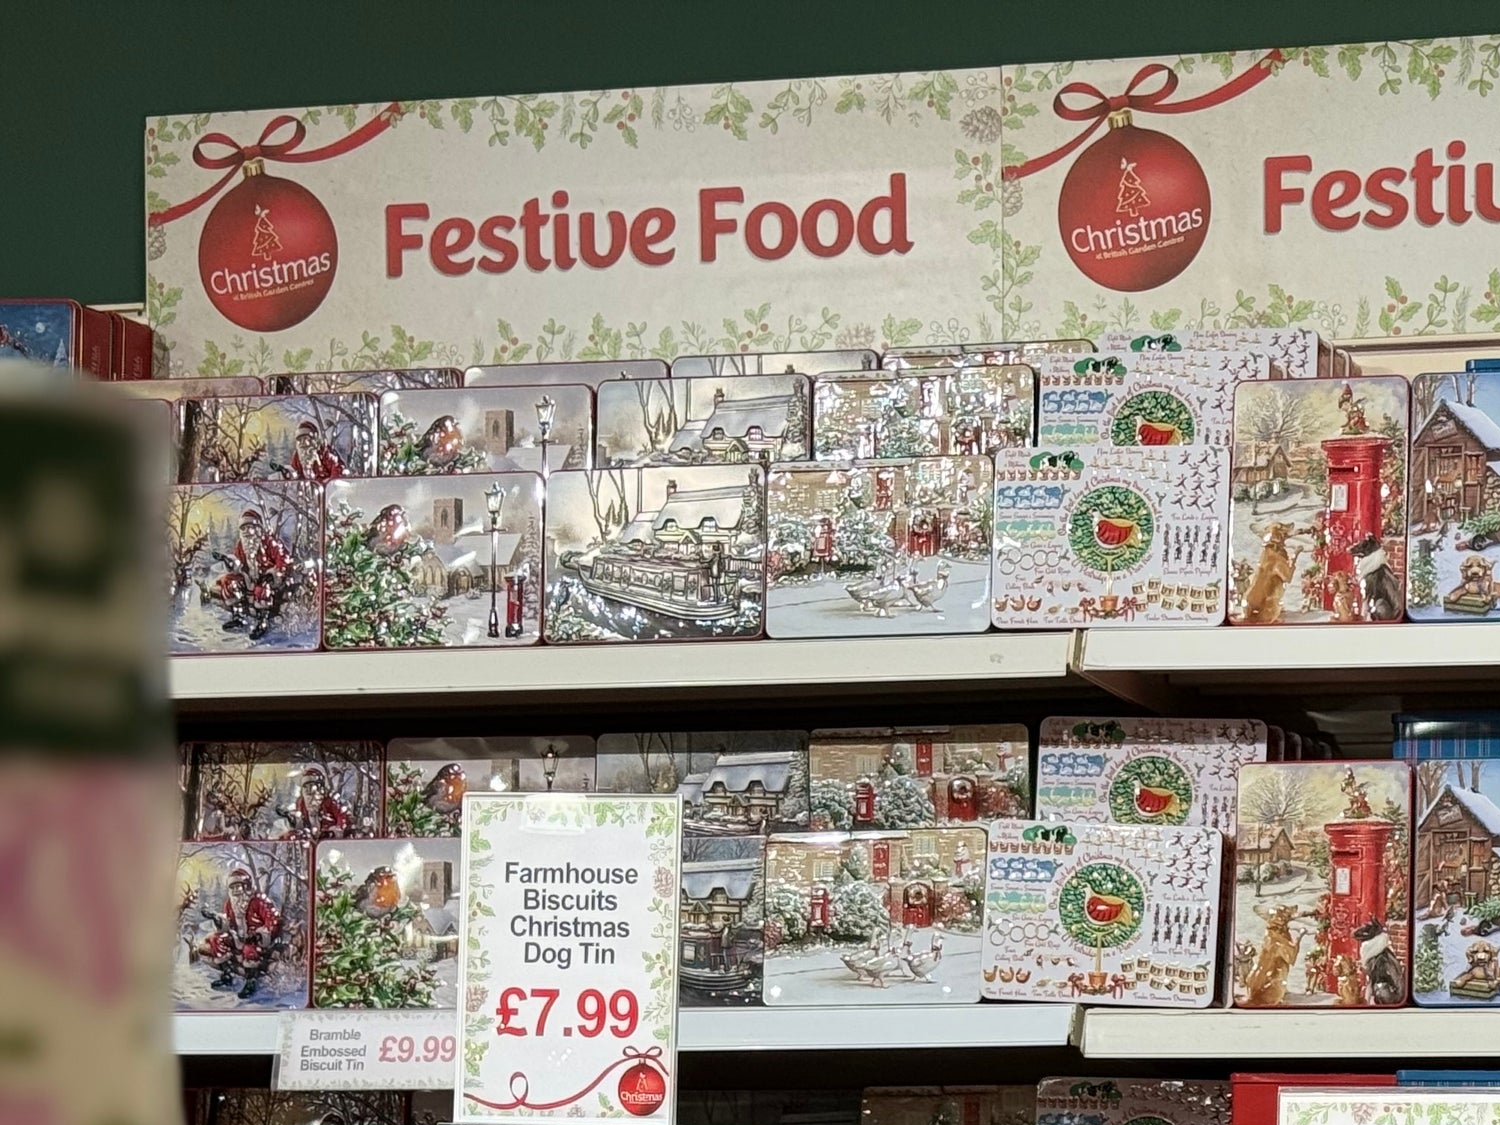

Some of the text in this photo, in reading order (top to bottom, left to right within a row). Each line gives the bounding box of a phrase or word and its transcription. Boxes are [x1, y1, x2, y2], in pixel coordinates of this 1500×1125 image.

[386, 173, 914, 279] Festive Food
[1071, 208, 1203, 253] Christmas
[210, 252, 331, 294] Christmas
[505, 861, 638, 885] Farmhouse
[524, 888, 618, 911] Biscuits
[510, 914, 630, 938] Christmas
[524, 942, 615, 969] Dog Tin
[496, 988, 639, 1038] £7.99
[310, 1028, 361, 1041] Bramble
[301, 1045, 366, 1059] Embossed
[379, 1036, 456, 1063] £9.99
[300, 1059, 364, 1072] Biscuit Tin
[620, 1088, 664, 1103] Christmas
